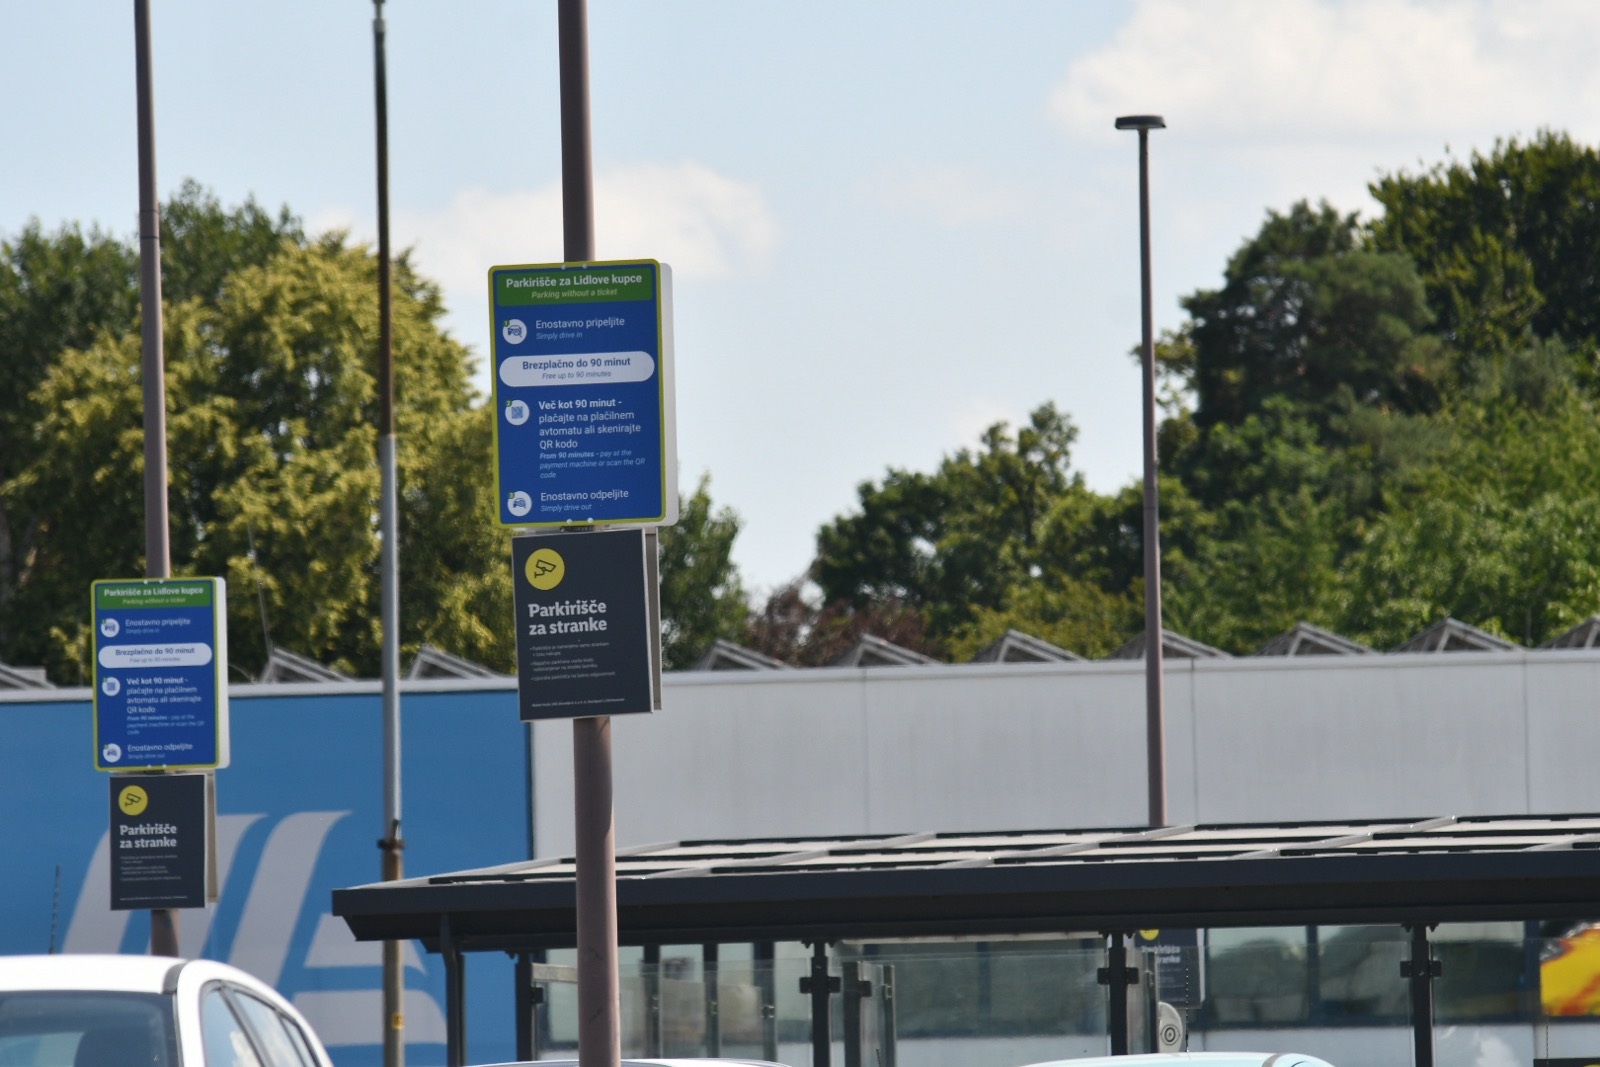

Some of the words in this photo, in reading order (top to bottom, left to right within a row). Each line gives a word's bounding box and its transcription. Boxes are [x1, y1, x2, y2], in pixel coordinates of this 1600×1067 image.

[506, 277, 556, 288] Parkirišče
[574, 275, 609, 285] Lidlove
[612, 274, 642, 284] kupce
[532, 291, 559, 299] Parking
[536, 319, 583, 329] Enostavno
[586, 317, 625, 328] pripeljite
[523, 360, 574, 371] Brezplačno
[576, 359, 587, 367] do
[590, 358, 602, 367] 90
[604, 358, 630, 366] minut
[538, 400, 556, 410] Več
[539, 414, 574, 424] plačajte
[591, 412, 634, 422] plačilnem
[540, 427, 582, 436] avtomatu
[584, 426, 595, 434] ali
[598, 424, 641, 434] skenirajte
[540, 441, 553, 450] QR
[556, 440, 577, 448] kodo
[541, 492, 588, 501] Enostavno
[590, 490, 628, 501] odpeljite
[181, 587, 203, 595] kupce
[528, 600, 606, 617] Parkirišče
[162, 618, 190, 626] pripeljite
[529, 624, 546, 635] za
[550, 617, 607, 633] stranke
[120, 824, 177, 835] Parkirišče
[120, 840, 132, 848] za
[135, 837, 176, 848] stranke
